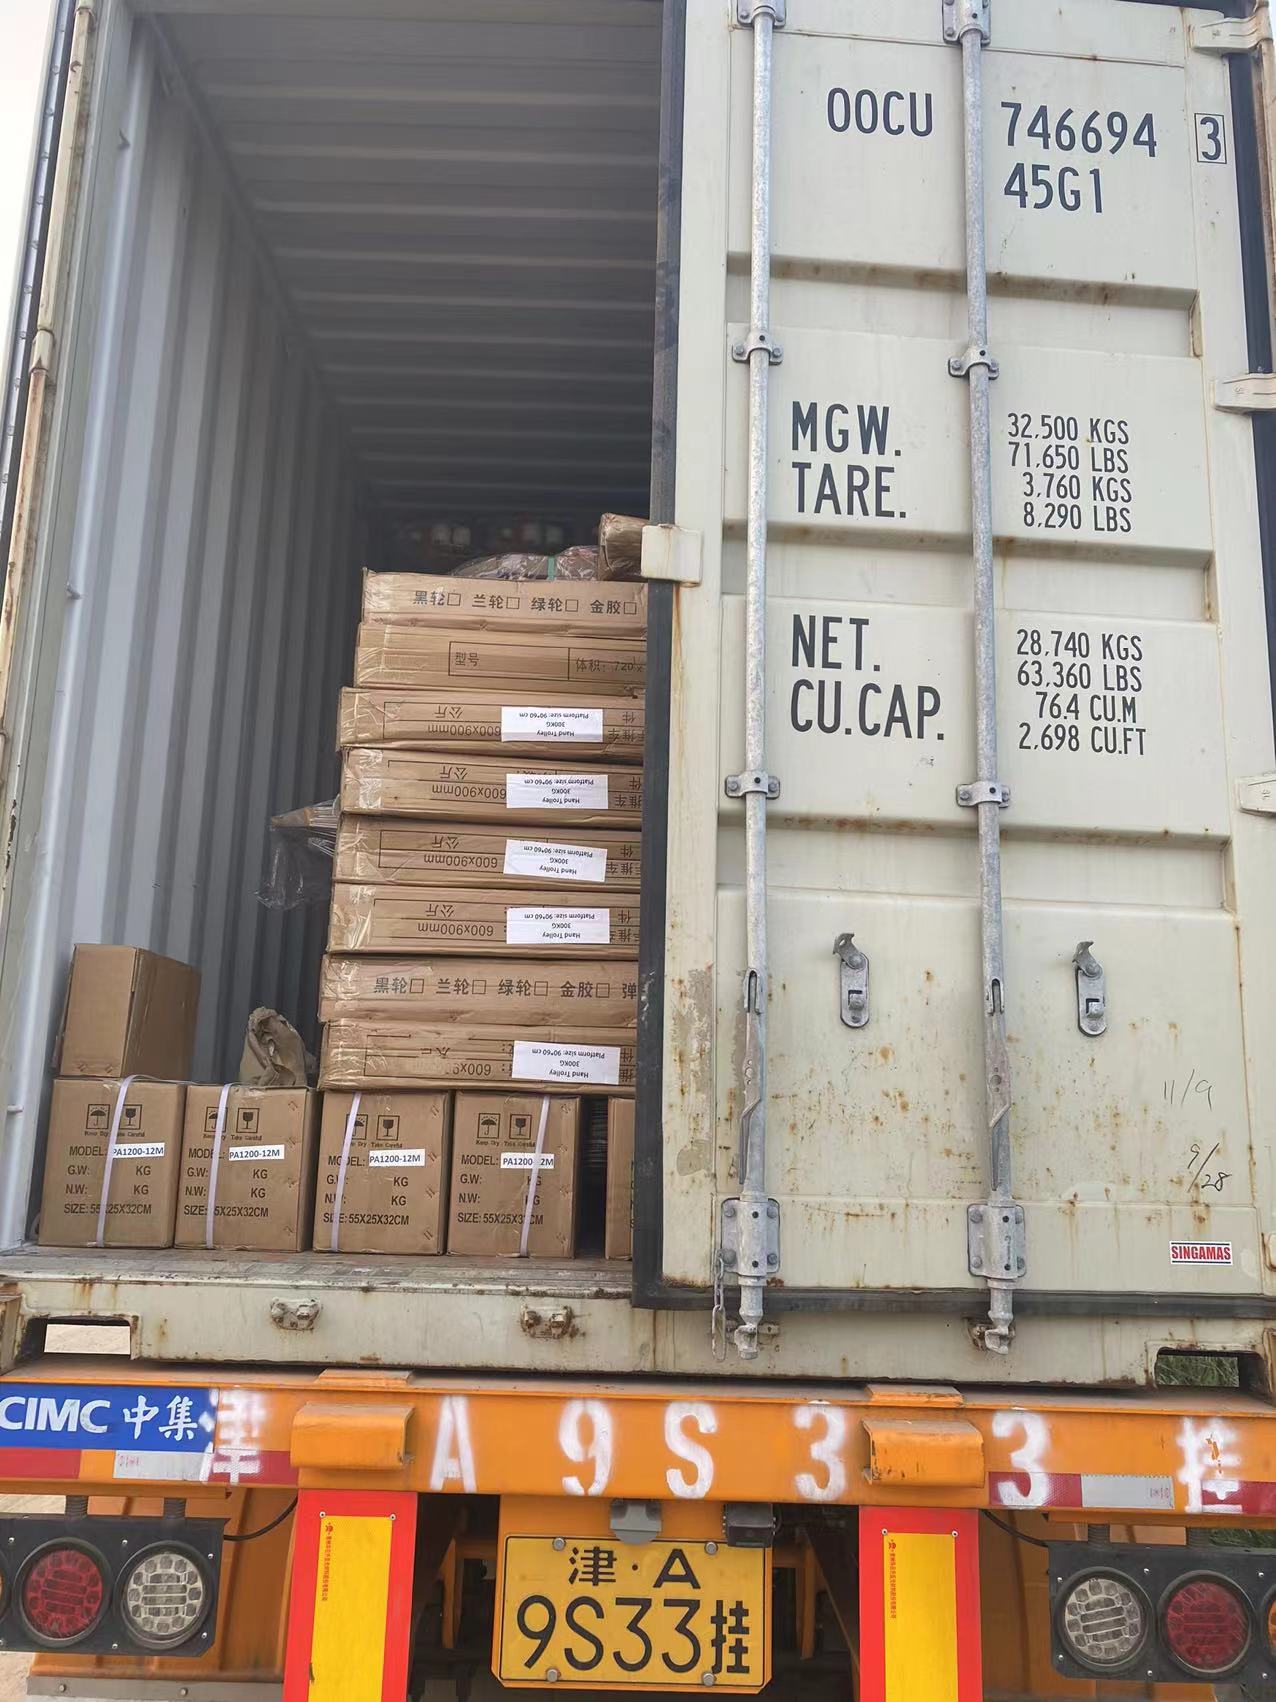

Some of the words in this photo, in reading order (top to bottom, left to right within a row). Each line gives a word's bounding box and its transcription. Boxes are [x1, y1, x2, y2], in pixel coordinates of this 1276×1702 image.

[826, 86, 933, 138] OOCU
[1000, 101, 1158, 159] 746694
[1200, 116, 1222, 162] 3
[1003, 162, 1103, 214] 45G1
[791, 400, 902, 457] MGW.
[1007, 412, 1079, 442] 32,500
[1089, 417, 1130, 445] KGS
[1008, 441, 1080, 471] 71,650
[1090, 446, 1129, 474] LBS
[791, 461, 907, 519] TARE.
[1022, 471, 1081, 500] 3,760
[1092, 475, 1132, 504] KGS
[1023, 501, 1082, 530] 8,290
[1093, 505, 1132, 533] LBS
[472, 594, 504, 610] 兰轮
[530, 597, 563, 612] 绿轮
[590, 599, 621, 615] 金胶
[791, 613, 881, 672] NET.
[1016, 628, 1090, 659] 28,740
[1101, 633, 1143, 661] KGS
[455, 651, 479, 667] 型号
[1017, 660, 1091, 690] 63,360
[1103, 664, 1142, 693] LBS
[434, 705, 463, 719] 公斤
[790, 678, 945, 741] CU.CAP.
[1035, 691, 1080, 721] 76.4
[1089, 694, 1137, 724] CU.M
[562, 712, 589, 720] Platform
[622, 711, 636, 724] 件
[427, 724, 502, 737] 600x900mm
[536, 729, 558, 737] Trolley
[1018, 722, 1080, 752] 2,698
[1090, 725, 1146, 756] CU.FT
[439, 765, 469, 780] 公斤
[431, 784, 507, 800] 600x900mm
[431, 835, 459, 850] 公斤
[567, 850, 593, 858] Platform
[620, 844, 634, 858] 件
[423, 853, 498, 869] 600x900mm
[539, 864, 559, 873] Trolley
[549, 857, 569, 865] 300KG
[425, 903, 455, 918] 公斤
[617, 909, 632, 924] 件
[417, 922, 494, 937] 600x900mm
[541, 931, 564, 939] Trolley
[373, 976, 408, 995] 黑轮
[435, 977, 470, 995] 兰轮
[497, 978, 532, 997] 绿轮
[560, 980, 594, 999] 金胶
[577, 1050, 605, 1059] Platform
[549, 1068, 571, 1078] Trolley
[571, 1070, 589, 1078] Hand
[229, 1149, 280, 1159] PA1200-12M
[369, 1154, 421, 1164] PA1200-12M
[460, 1154, 499, 1166] MODEL:
[502, 1157, 554, 1166] PA1200-2M
[67, 1164, 90, 1175] G.W:
[135, 1165, 151, 1176] KG
[187, 1167, 209, 1178] G.W:
[252, 1168, 268, 1180] KG
[393, 1176, 409, 1187] KG
[460, 1173, 482, 1184] G.W:
[65, 1183, 88, 1195] N.W:
[133, 1184, 149, 1195] KG
[185, 1186, 207, 1197] N.W:
[250, 1187, 266, 1199] KG
[391, 1195, 407, 1206] KG
[458, 1193, 480, 1204] N.W:
[90, 1204, 152, 1215] 5525X32CM
[212, 1206, 269, 1217] 5X25X32CM
[1170, 1245, 1232, 1261] SINGAMAS
[0, 1396, 109, 1435] CIMC
[122, 1394, 200, 1441] 中集
[429, 1396, 477, 1493] A
[558, 1399, 614, 1496] 9
[664, 1400, 718, 1499] S
[793, 1403, 849, 1501] 3
[991, 1411, 1052, 1510] 3
[516, 1594, 751, 1675] 9S33挂
